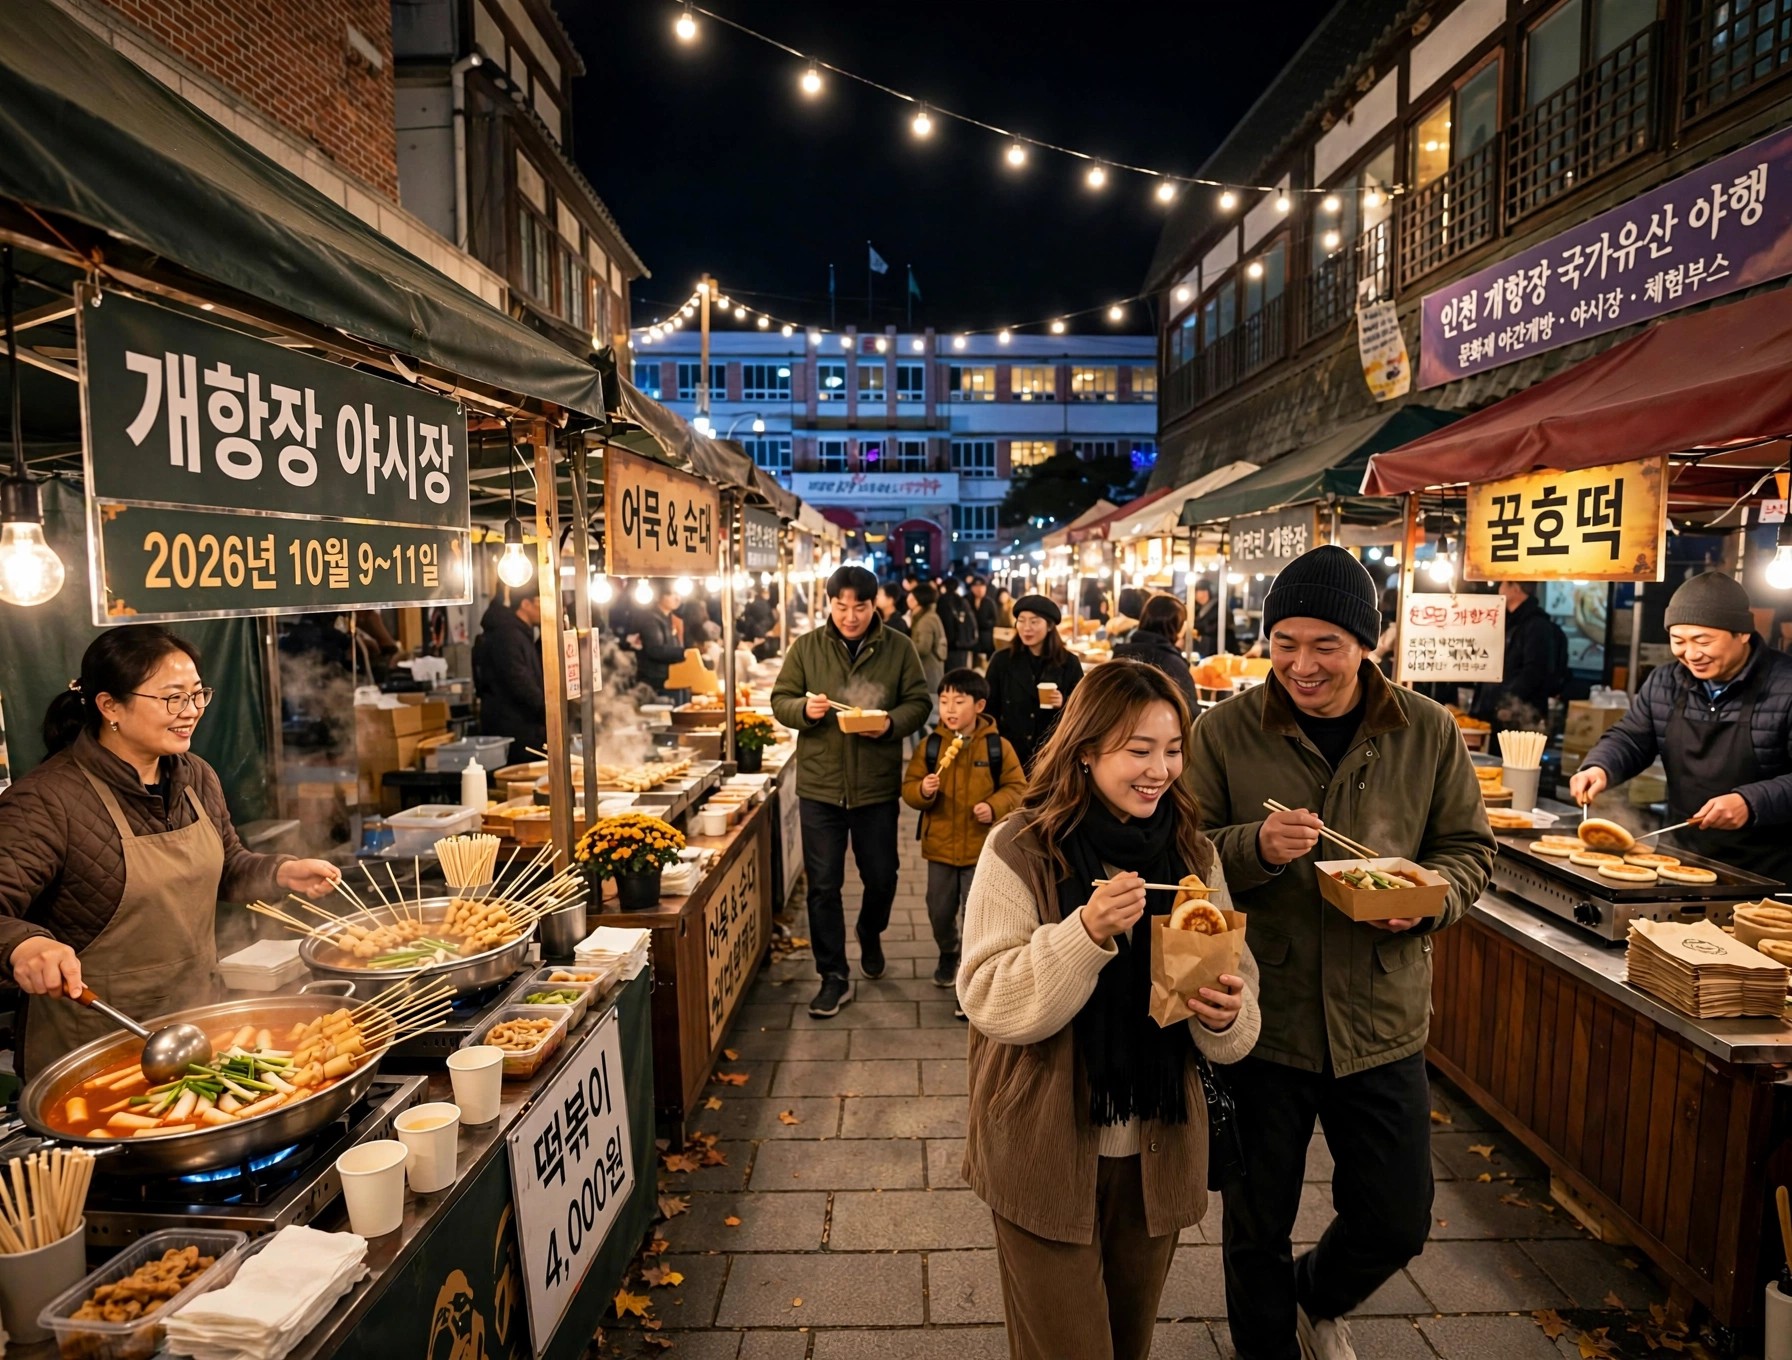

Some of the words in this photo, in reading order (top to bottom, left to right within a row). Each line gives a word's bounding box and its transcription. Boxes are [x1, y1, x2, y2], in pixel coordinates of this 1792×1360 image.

[1440, 289, 1478, 339] 인천
[1483, 259, 1551, 320] 개항장
[1557, 203, 1679, 291] 국가유산
[1688, 163, 1768, 240] 야행
[1498, 311, 1555, 352] 야간개방
[1570, 287, 1624, 328] 야시장
[1643, 253, 1730, 304] 체험부스
[125, 351, 323, 487] 개항장
[336, 403, 454, 504] 야시장
[143, 531, 277, 590] 2026년
[289, 538, 349, 588] 10월
[358, 542, 439, 588] 9~11일
[621, 485, 662, 551] 어묵
[667, 500, 678, 547] &
[683, 499, 712, 555] 순대
[1487, 478, 1624, 562] 꿀호떡
[709, 892, 728, 959] 어묵
[533, 1050, 611, 1189] 떡볶이
[545, 1125, 626, 1290] 4,000원
